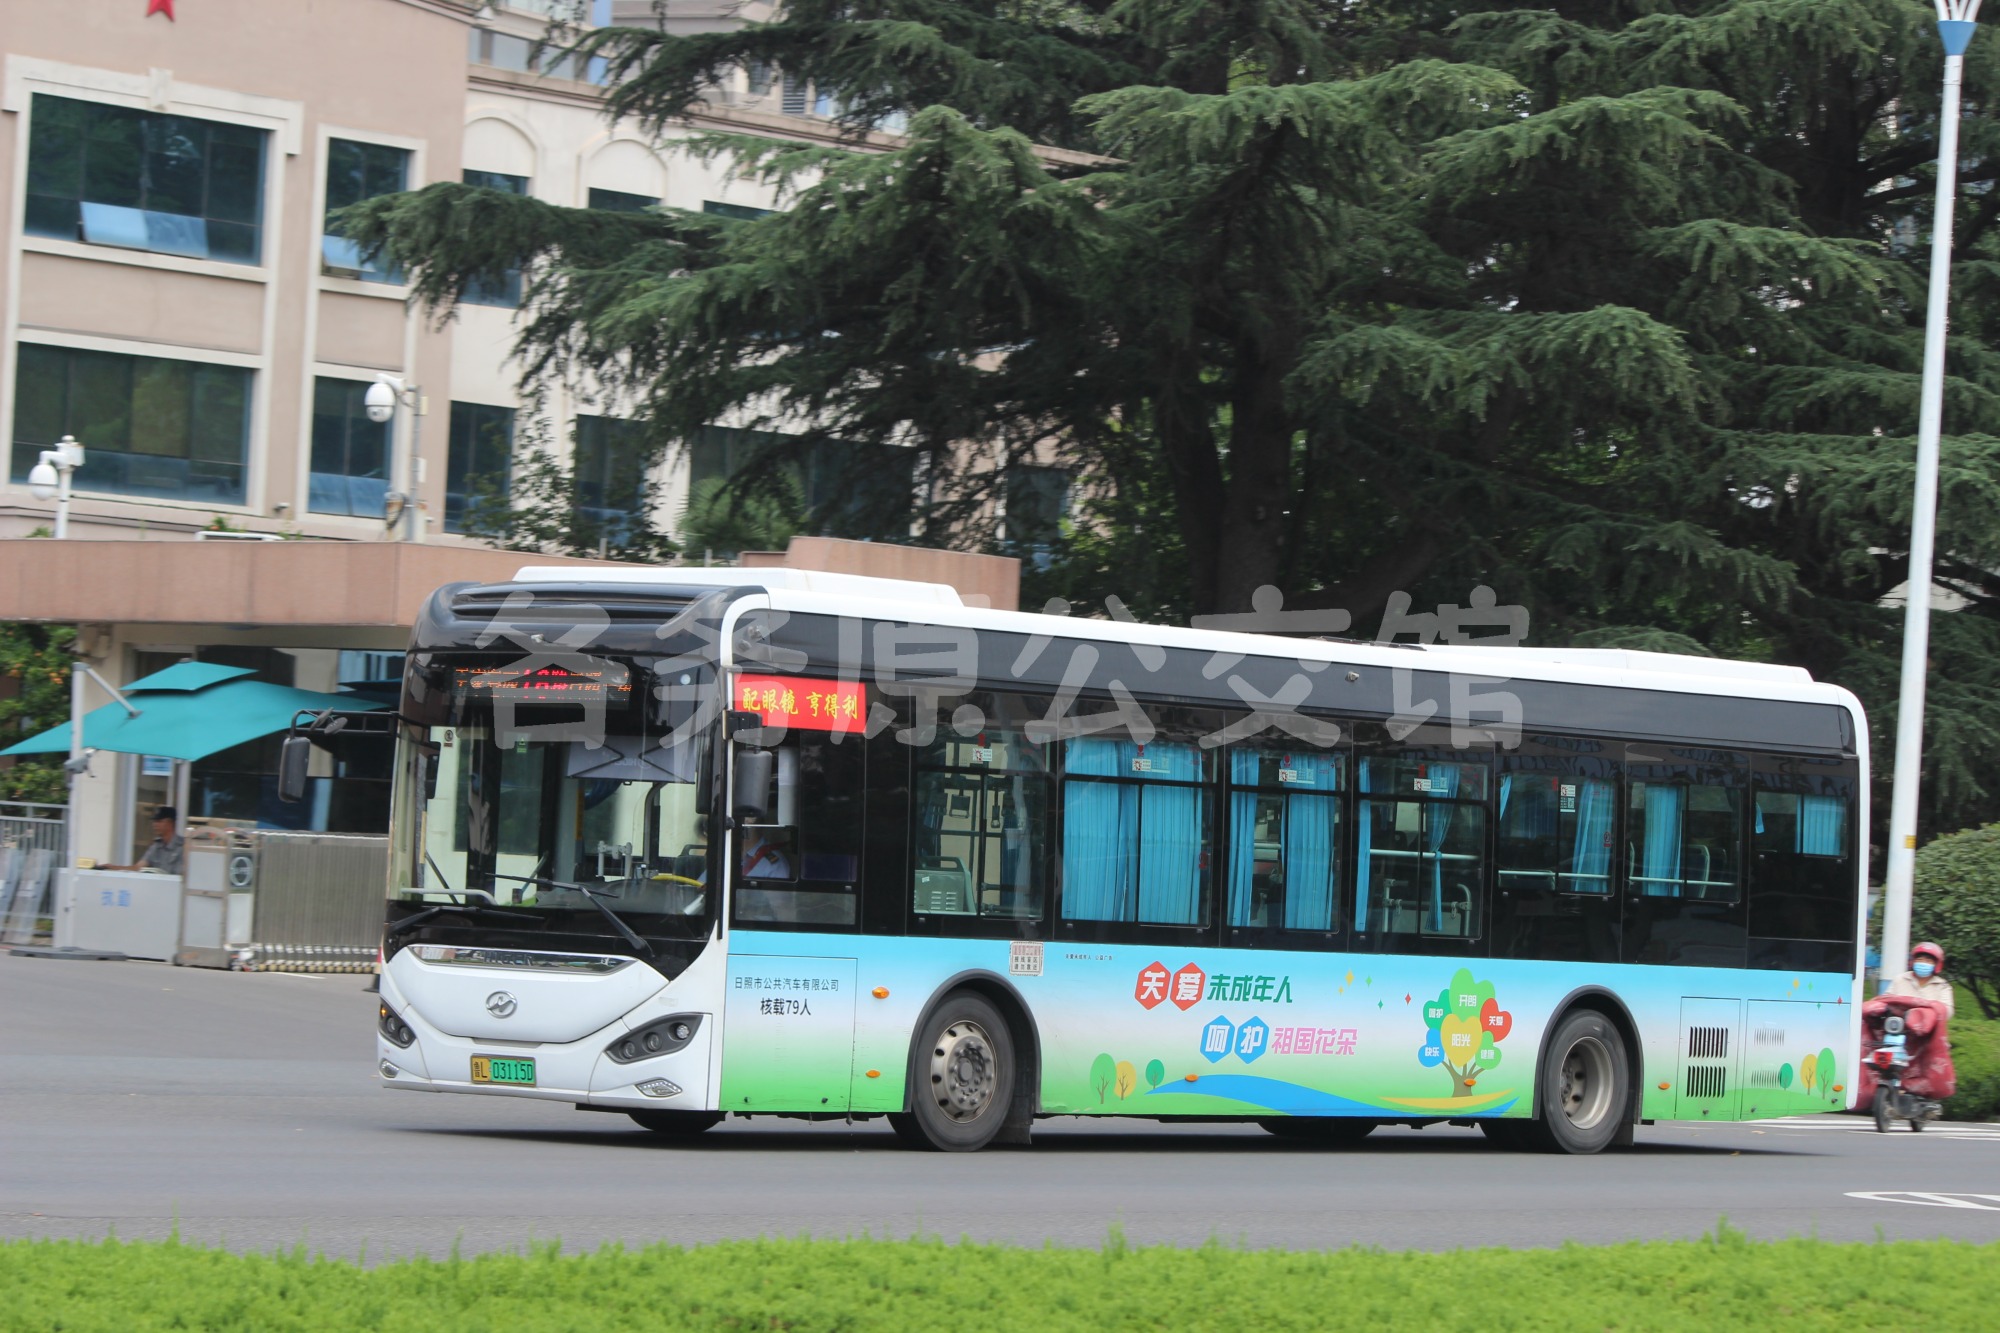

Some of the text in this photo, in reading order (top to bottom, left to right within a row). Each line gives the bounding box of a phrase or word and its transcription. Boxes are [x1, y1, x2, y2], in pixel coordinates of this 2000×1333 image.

[742, 688, 859, 719] 配眼镜 亨得利
[735, 977, 839, 991] 日照市公共汽车有限公司
[1140, 970, 1293, 1003] 关爱未成年人
[760, 997, 811, 1016] 核载79人
[1459, 994, 1477, 1007] 开朗
[1429, 1008, 1444, 1018] 呵护
[1488, 1015, 1504, 1026] 关爱
[1205, 1024, 1358, 1055] 呵护祖国花朵
[1451, 1033, 1471, 1047] 阳光
[1425, 1047, 1440, 1057] 快乐
[1480, 1049, 1495, 1059] 健康
